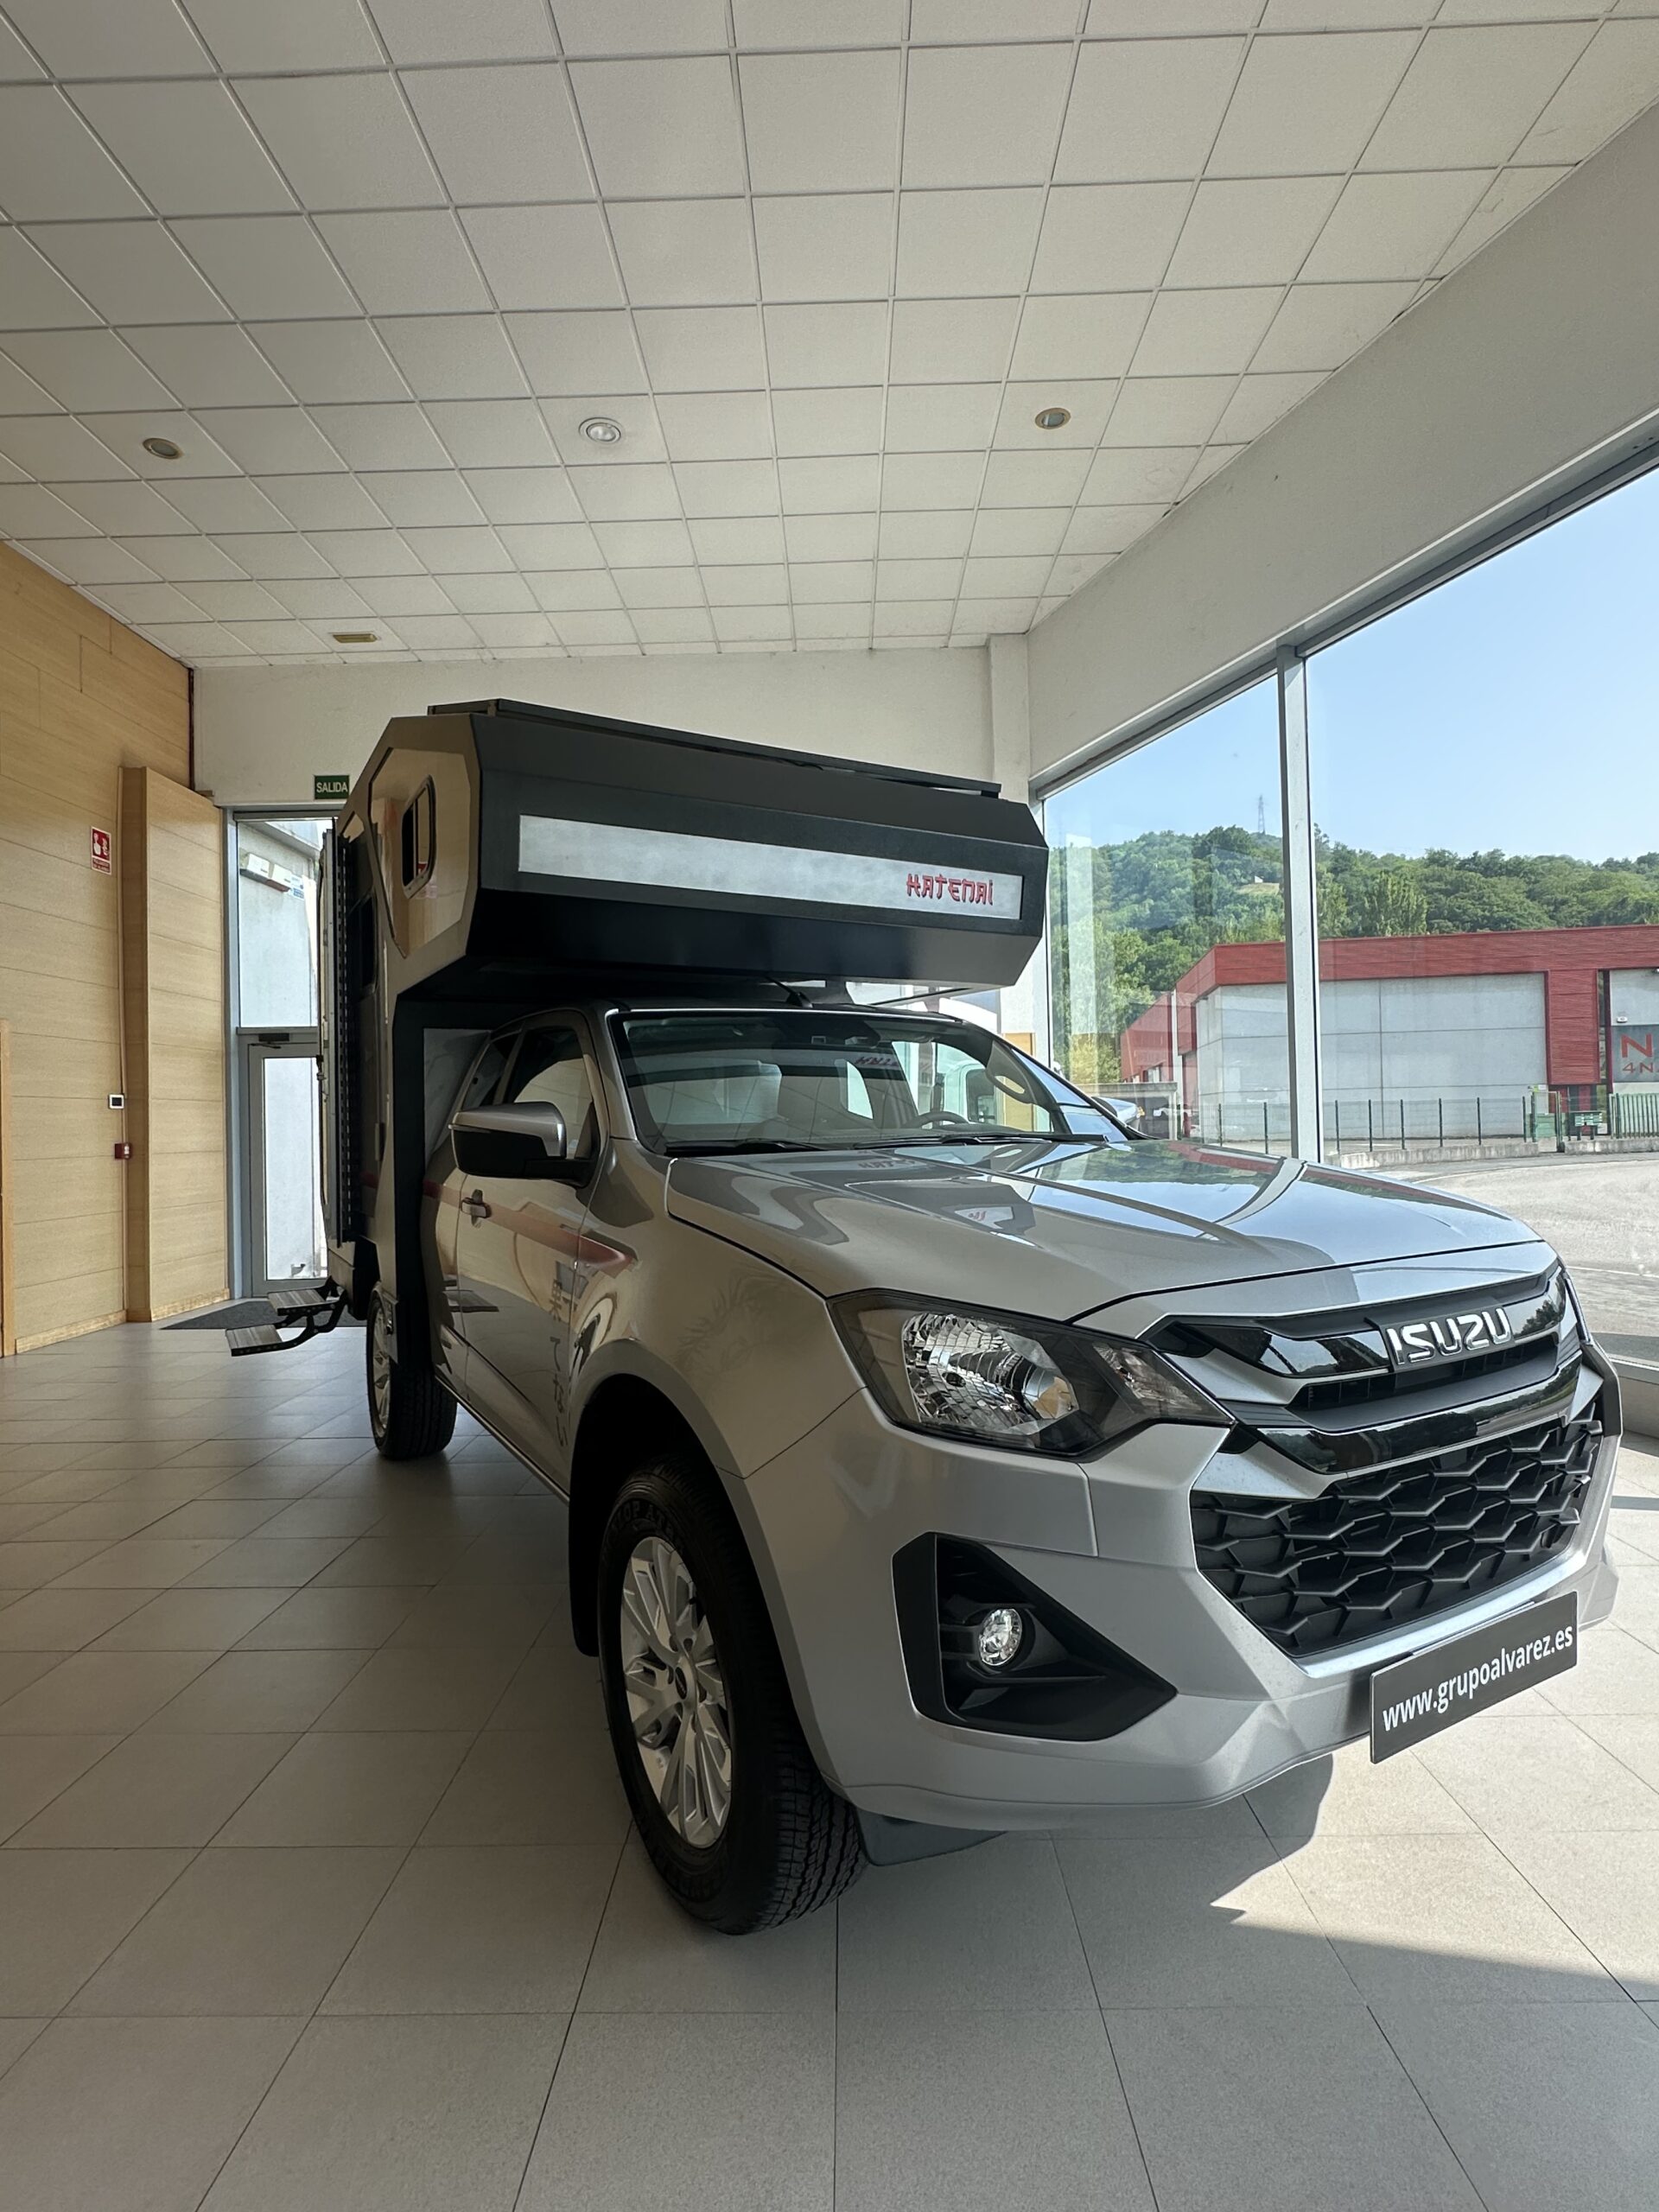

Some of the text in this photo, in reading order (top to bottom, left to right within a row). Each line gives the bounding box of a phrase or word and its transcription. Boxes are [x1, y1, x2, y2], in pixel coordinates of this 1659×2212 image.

[316, 781, 347, 793] SALIDA
[1386, 1307, 1512, 1365] ISUZU
[1382, 1625, 1573, 1732] www.grupoalvarez.es
